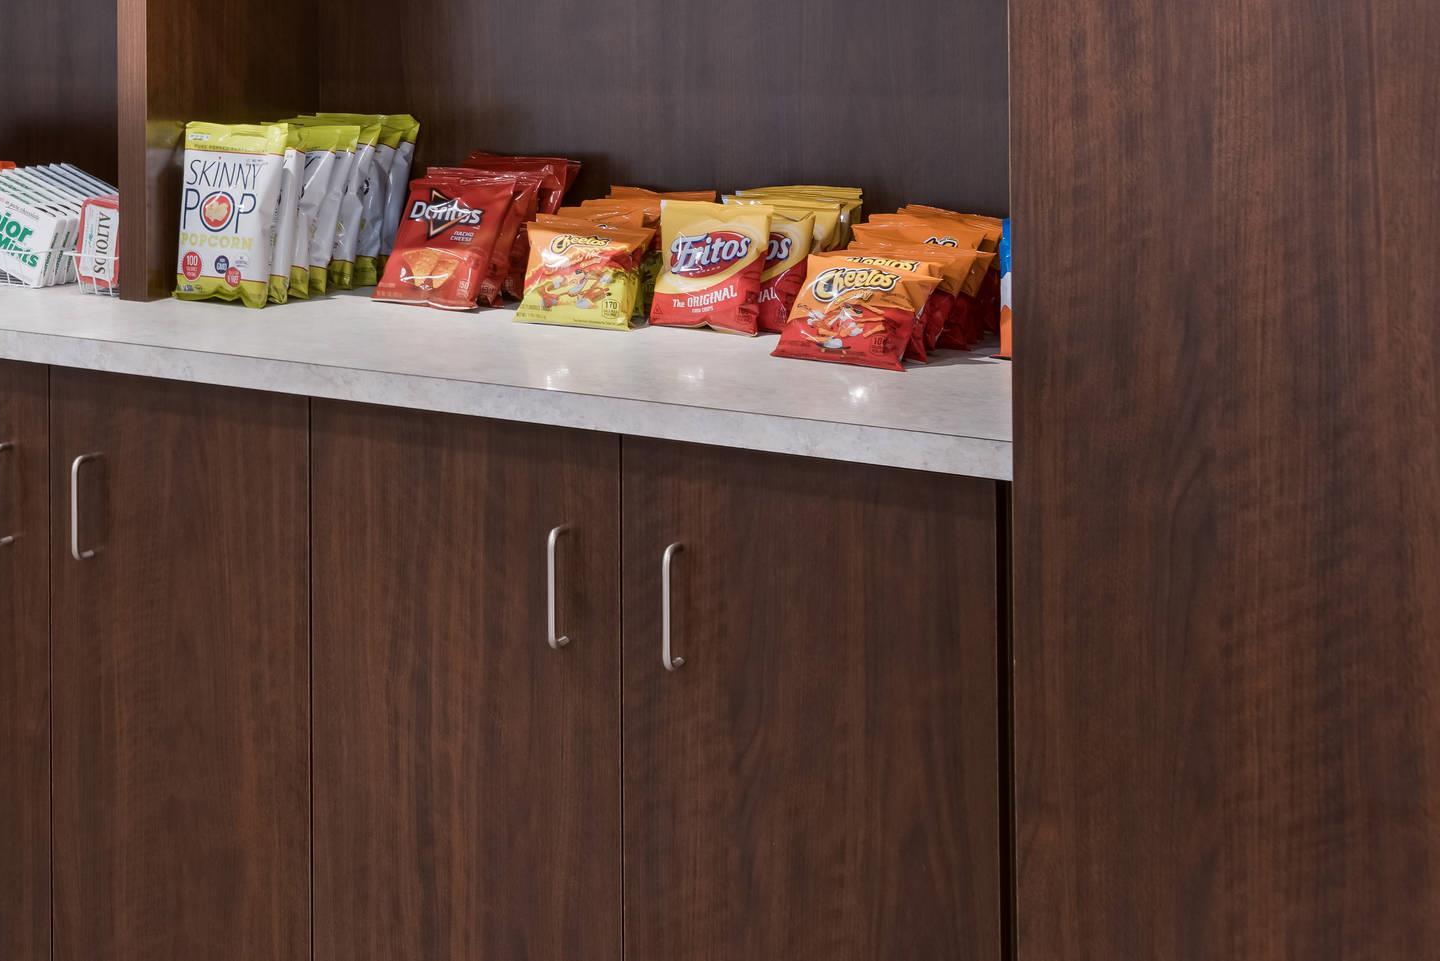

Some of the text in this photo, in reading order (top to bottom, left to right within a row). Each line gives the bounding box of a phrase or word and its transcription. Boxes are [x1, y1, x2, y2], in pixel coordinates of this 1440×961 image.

[186, 157, 263, 190] SKINNY
[183, 188, 257, 234] POP
[410, 201, 484, 225] Doritos
[94, 211, 111, 275] ALTOIDS
[181, 231, 254, 251] POPCORN
[551, 233, 611, 255] Cheetos
[670, 233, 752, 275] Fritos
[187, 255, 199, 266] 100
[672, 284, 738, 308] The ORIGINAL
[812, 267, 902, 302] Cheetos
